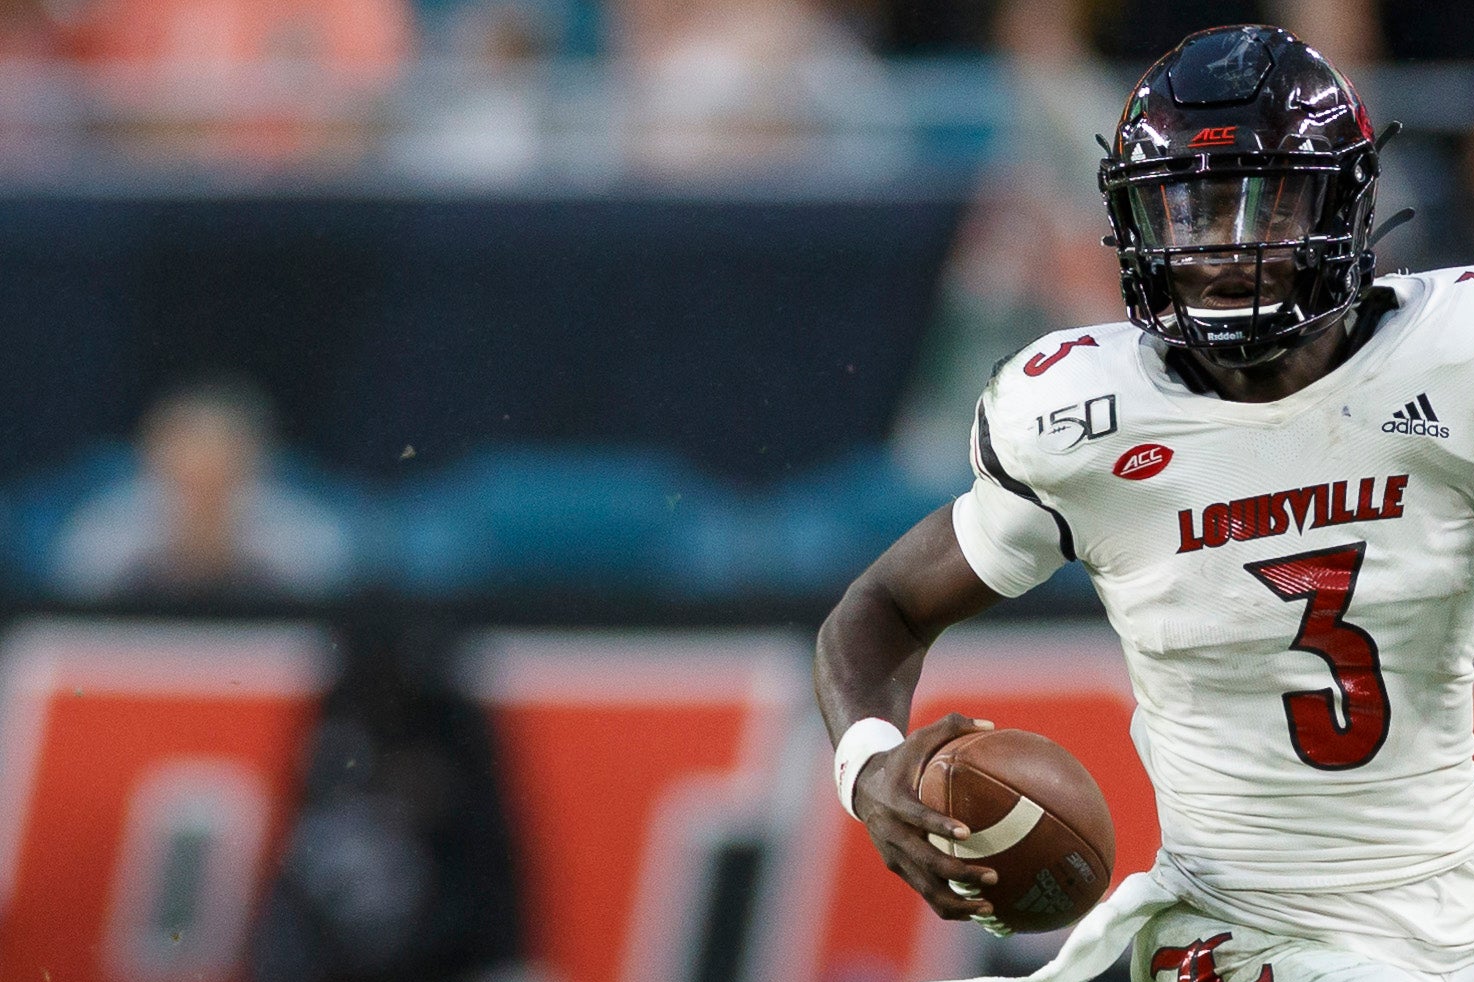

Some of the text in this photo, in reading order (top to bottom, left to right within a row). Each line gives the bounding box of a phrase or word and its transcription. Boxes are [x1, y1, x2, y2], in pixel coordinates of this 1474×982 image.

[1190, 126, 1237, 144] ACC
[1207, 331, 1244, 341] Riddell
[1023, 334, 1099, 377] 3
[1035, 394, 1118, 450] 150
[1381, 416, 1451, 439] adidas
[1122, 447, 1164, 471] ACC
[1176, 474, 1409, 553] LOUISVILLE
[1244, 541, 1391, 771] 3
